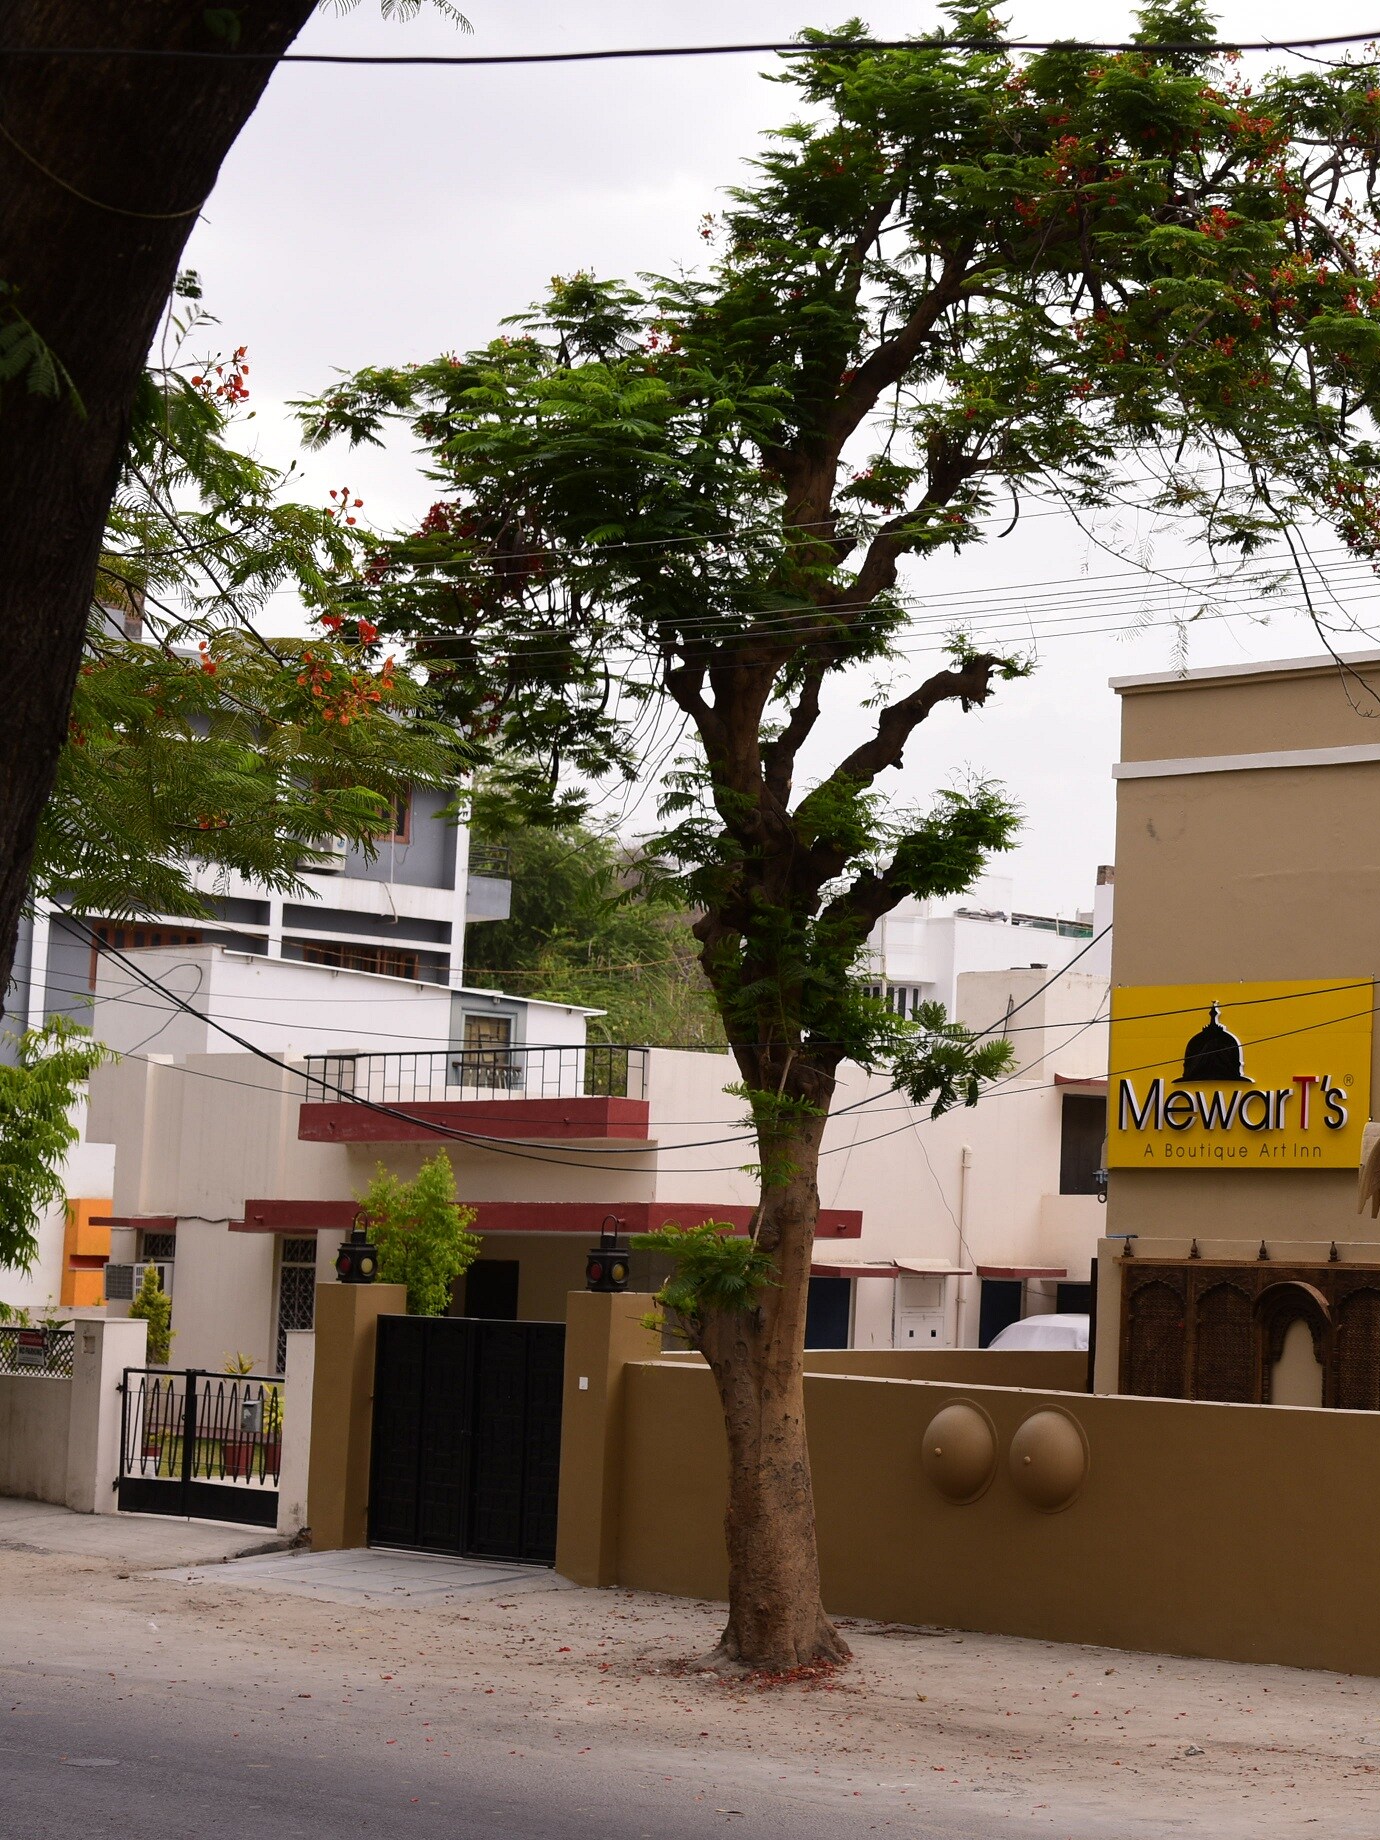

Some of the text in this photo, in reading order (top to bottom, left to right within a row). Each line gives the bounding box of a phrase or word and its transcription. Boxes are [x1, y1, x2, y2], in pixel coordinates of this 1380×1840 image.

[1118, 1074, 1349, 1131] MewarT's
[1143, 1143, 1323, 1161] A Boutique Art Inn
